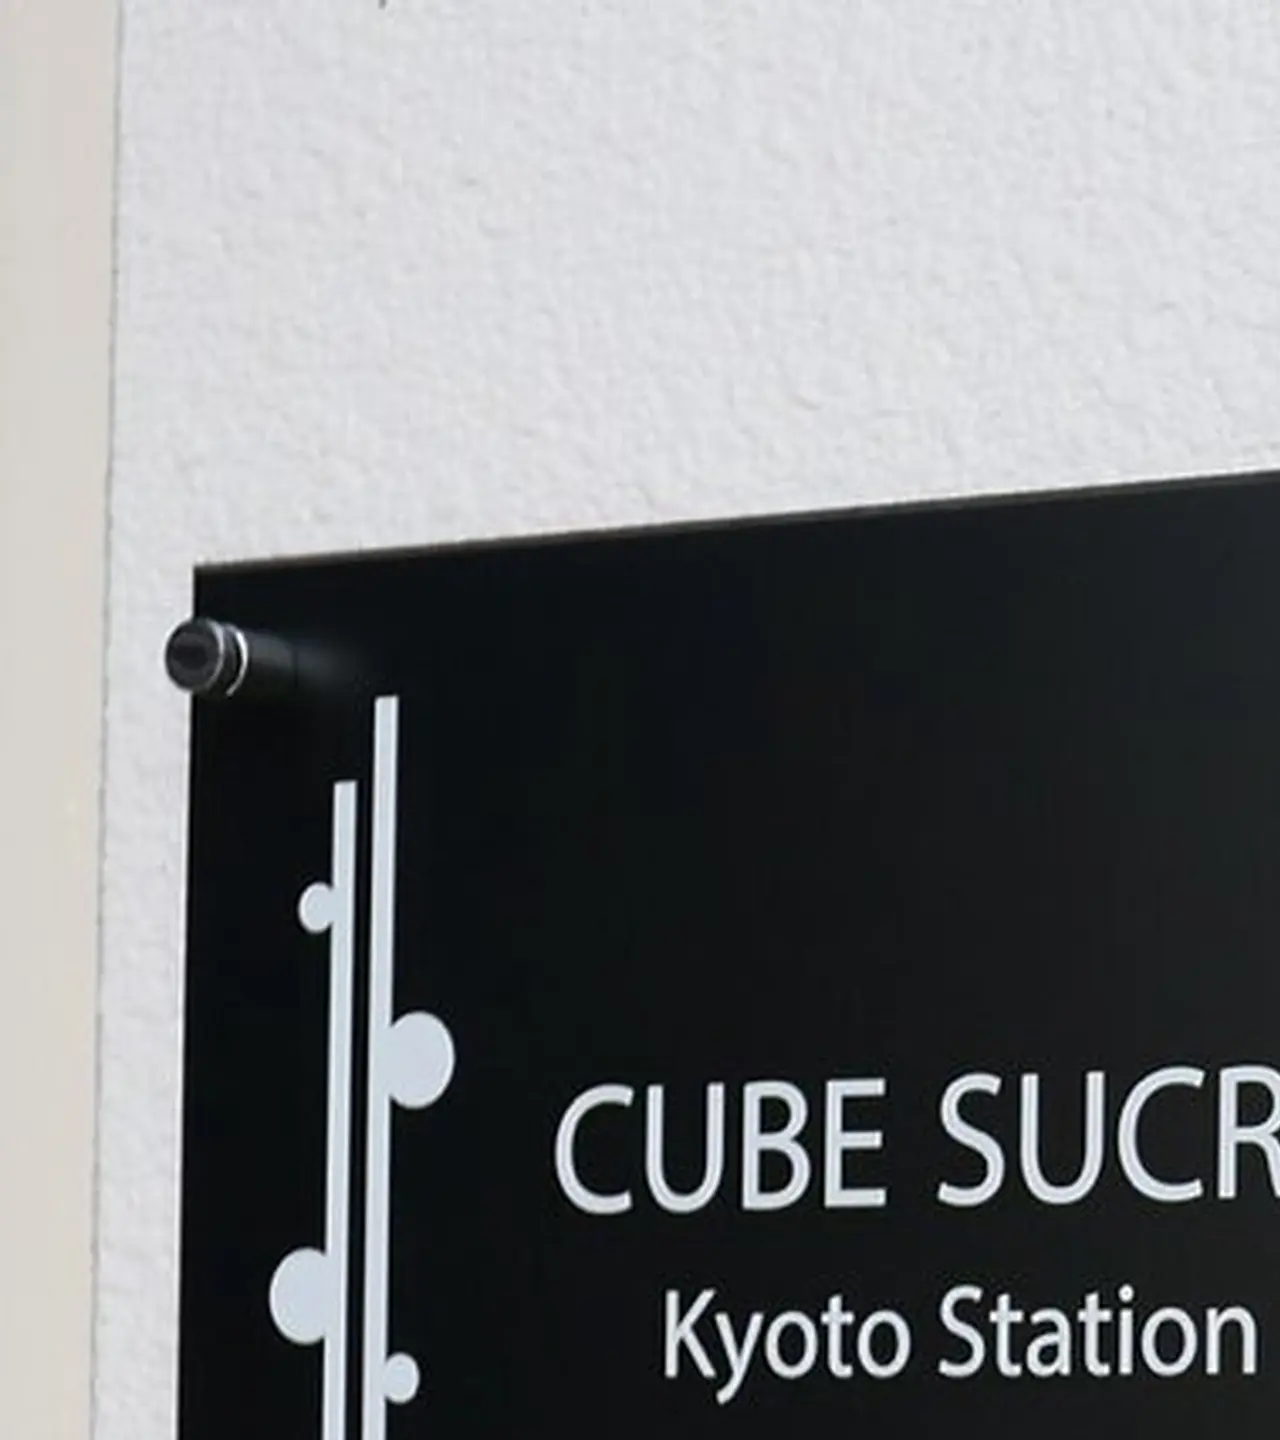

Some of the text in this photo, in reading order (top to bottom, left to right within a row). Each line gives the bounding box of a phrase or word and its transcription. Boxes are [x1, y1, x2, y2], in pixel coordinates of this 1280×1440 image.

[554, 1076, 888, 1215] CUBE
[663, 1283, 1258, 1406] Kyoto Station
